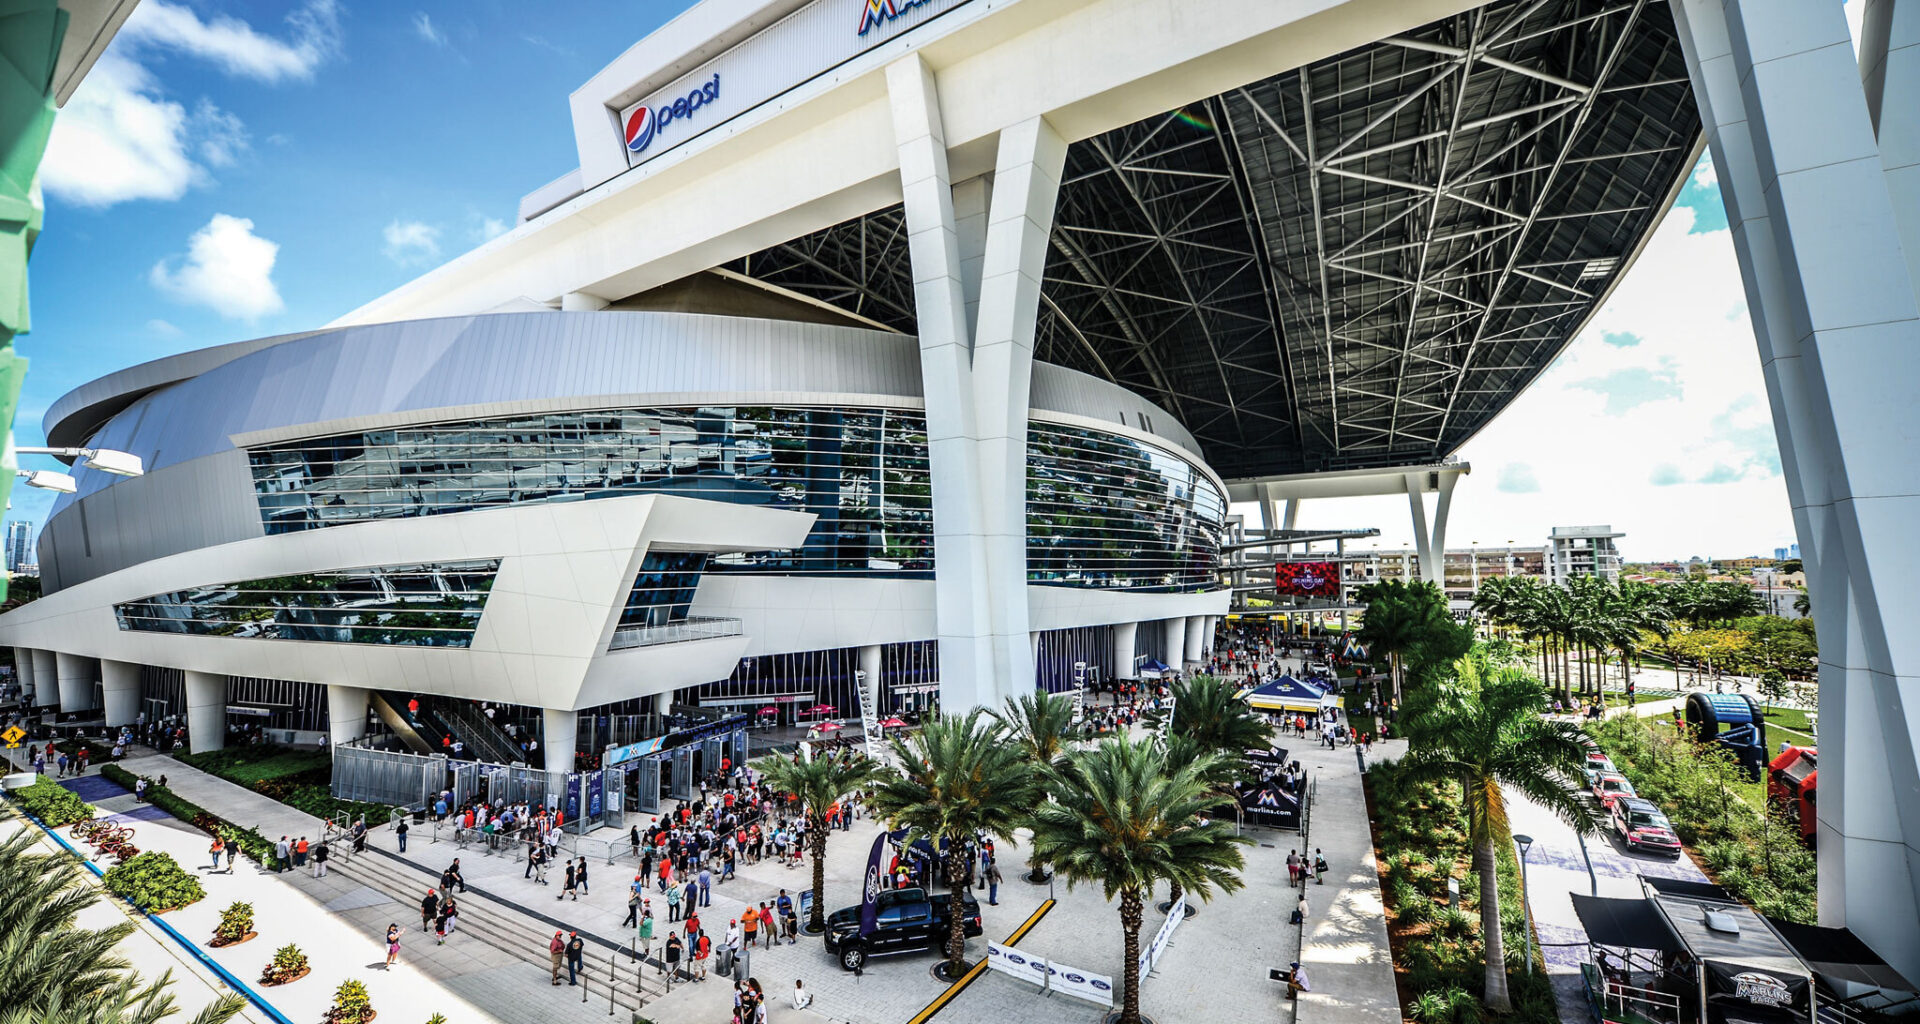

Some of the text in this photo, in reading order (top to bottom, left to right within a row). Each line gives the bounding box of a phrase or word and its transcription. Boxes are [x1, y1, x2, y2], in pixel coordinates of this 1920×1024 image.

[656, 73, 720, 134] pepsi
[1246, 807, 1292, 816] marlins.com
[867, 872, 877, 898] Ford
[1736, 982, 1793, 1005] MARLINS
[1750, 995, 1778, 1005] PARK
